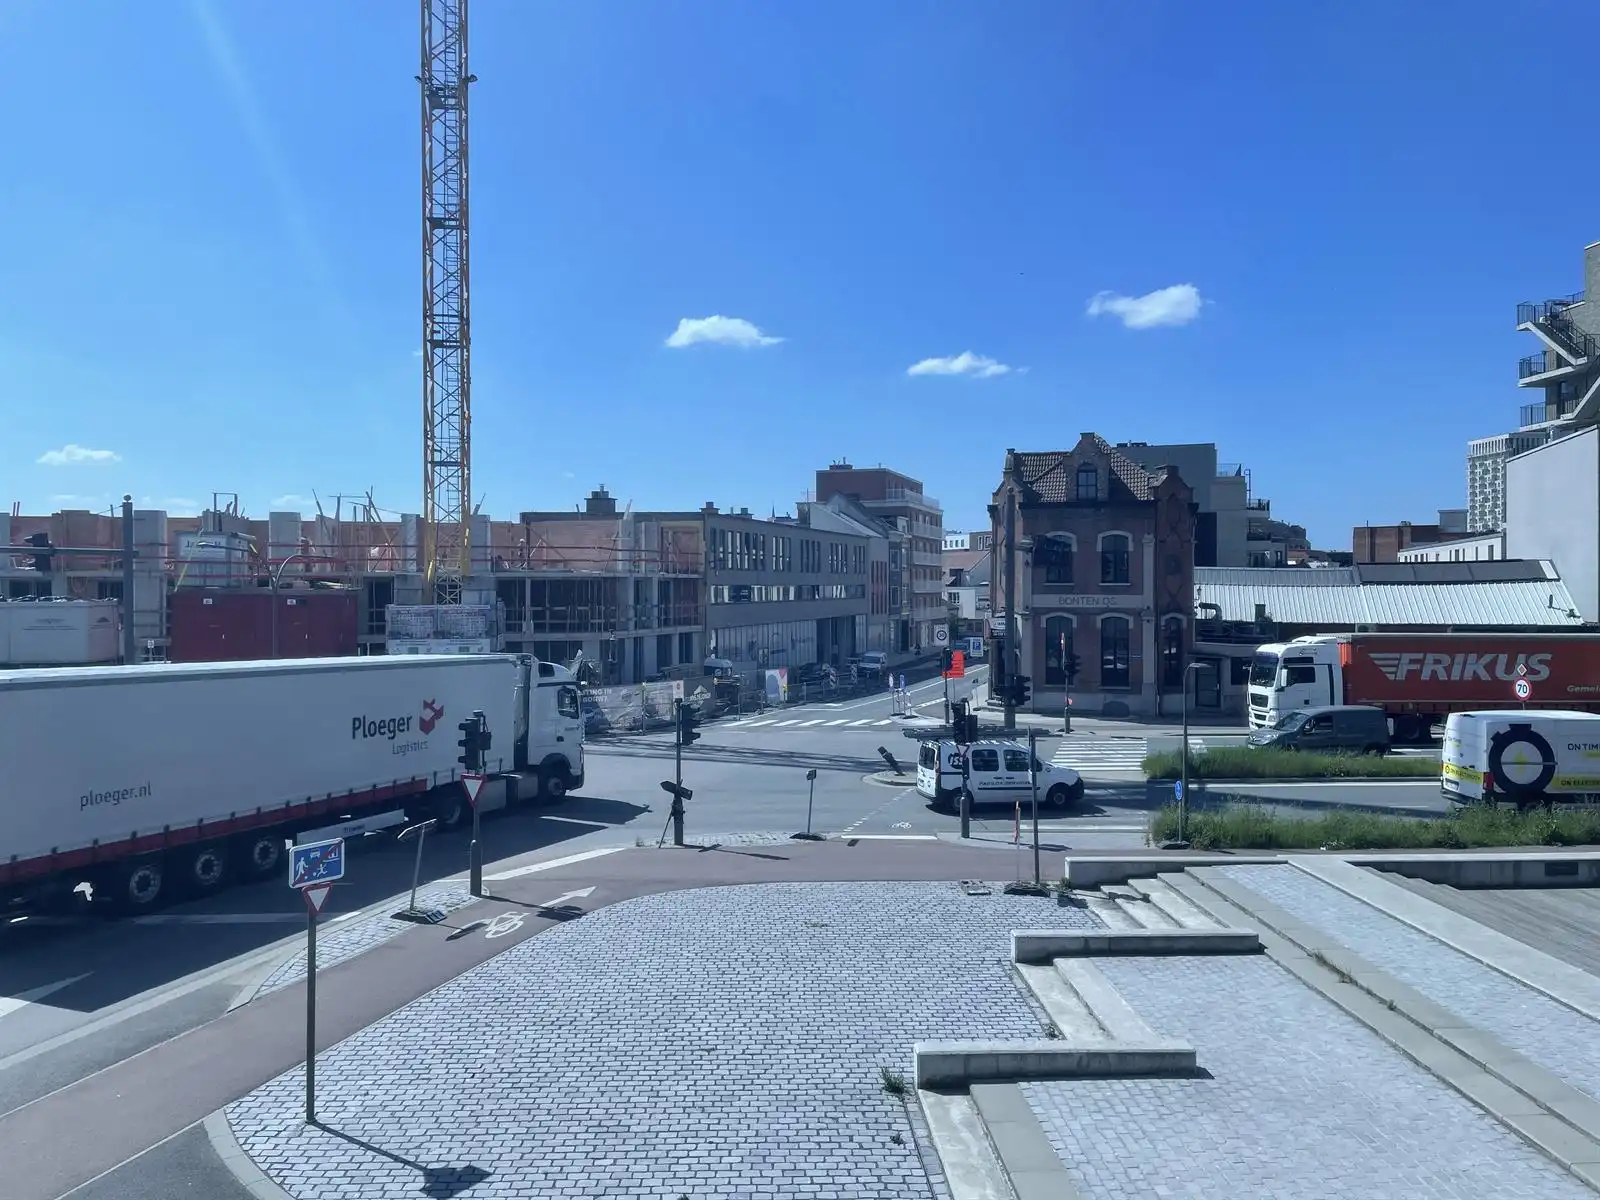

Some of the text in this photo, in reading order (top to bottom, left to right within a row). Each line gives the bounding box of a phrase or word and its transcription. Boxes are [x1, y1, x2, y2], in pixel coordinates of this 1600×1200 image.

[1395, 652, 1552, 682] FRIKUS
[1517, 683, 1528, 694] 70
[351, 714, 414, 741] Ploeger
[391, 740, 429, 757] Logistics
[1567, 743, 1581, 751] ON
[79, 779, 152, 812] ploeger.nl
